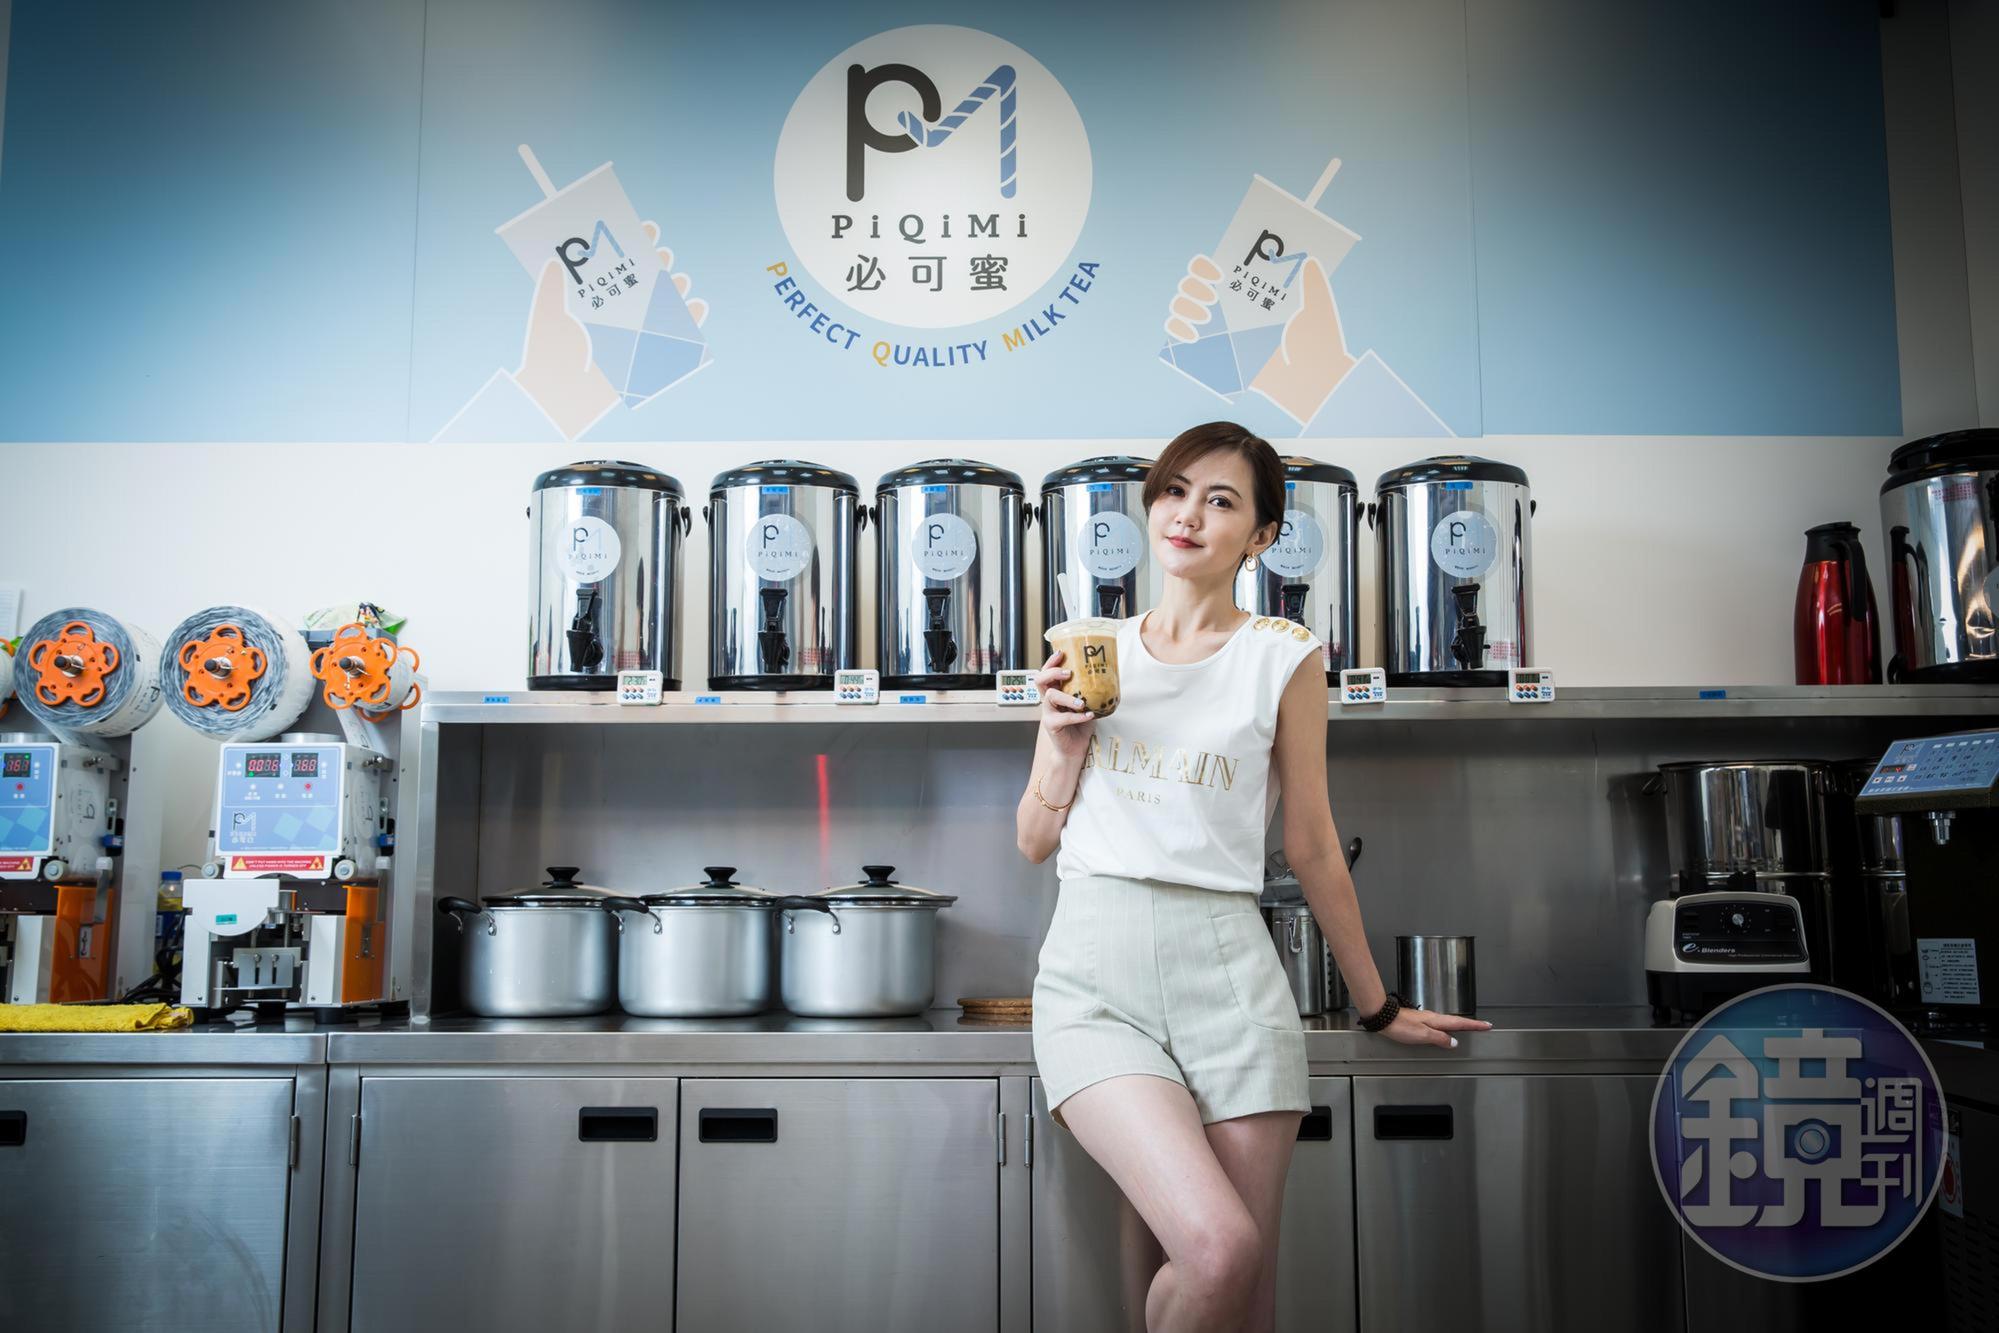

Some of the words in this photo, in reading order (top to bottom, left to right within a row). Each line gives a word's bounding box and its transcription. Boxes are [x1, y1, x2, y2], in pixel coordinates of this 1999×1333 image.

[831, 213, 1028, 244] PiQiMi
[591, 273, 639, 311] 必可蜜
[845, 254, 1010, 292] 必可蜜
[766, 261, 861, 351] PERFECT
[872, 340, 988, 367] QUALITY
[1002, 303, 1066, 352] MILK
[1058, 259, 1101, 305] TEA
[1229, 279, 1276, 312] 必可蜜
[1081, 733, 1240, 791] ALMAIN
[1116, 786, 1161, 805] PARIS
